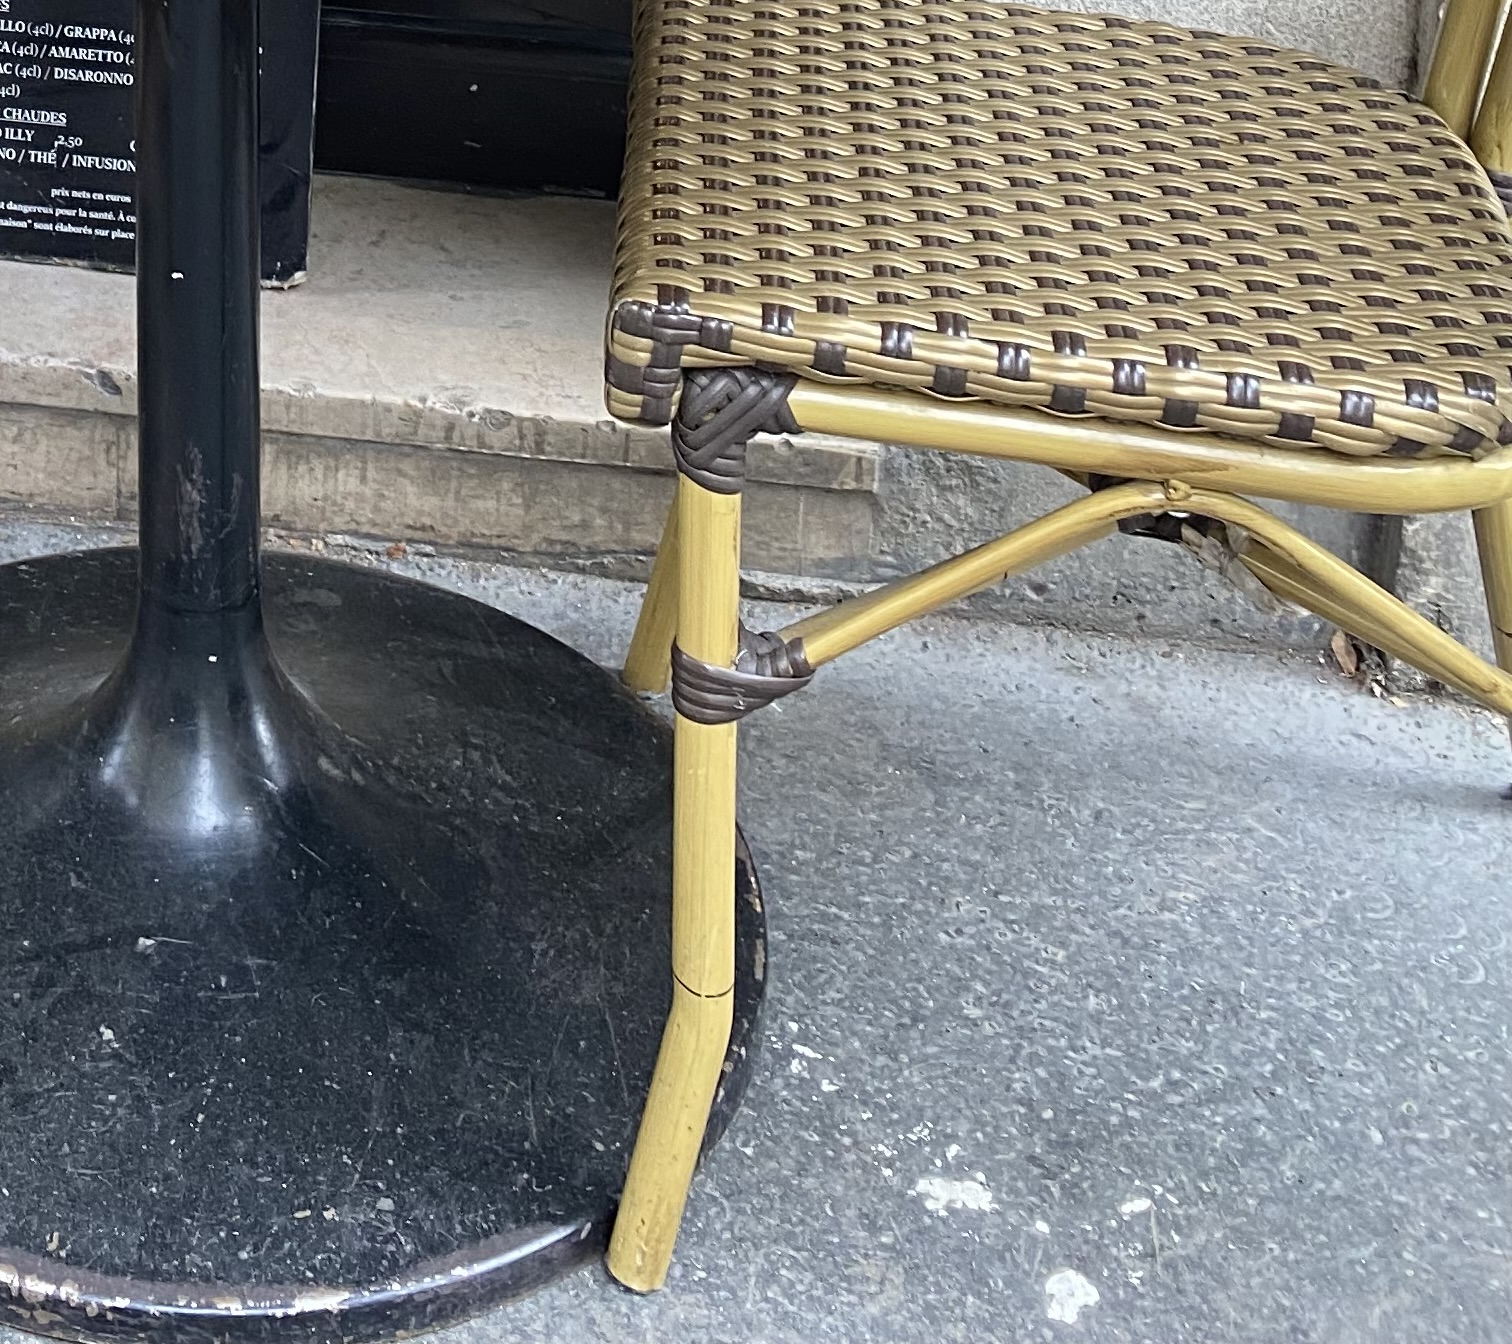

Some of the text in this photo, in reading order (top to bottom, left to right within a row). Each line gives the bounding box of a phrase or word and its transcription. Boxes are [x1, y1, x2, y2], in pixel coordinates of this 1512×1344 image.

[28, 22, 53, 38] (4cl)
[64, 25, 117, 42] GRAPPA
[4, 107, 66, 125] CHAUDES
[5, 128, 34, 142] ILLY
